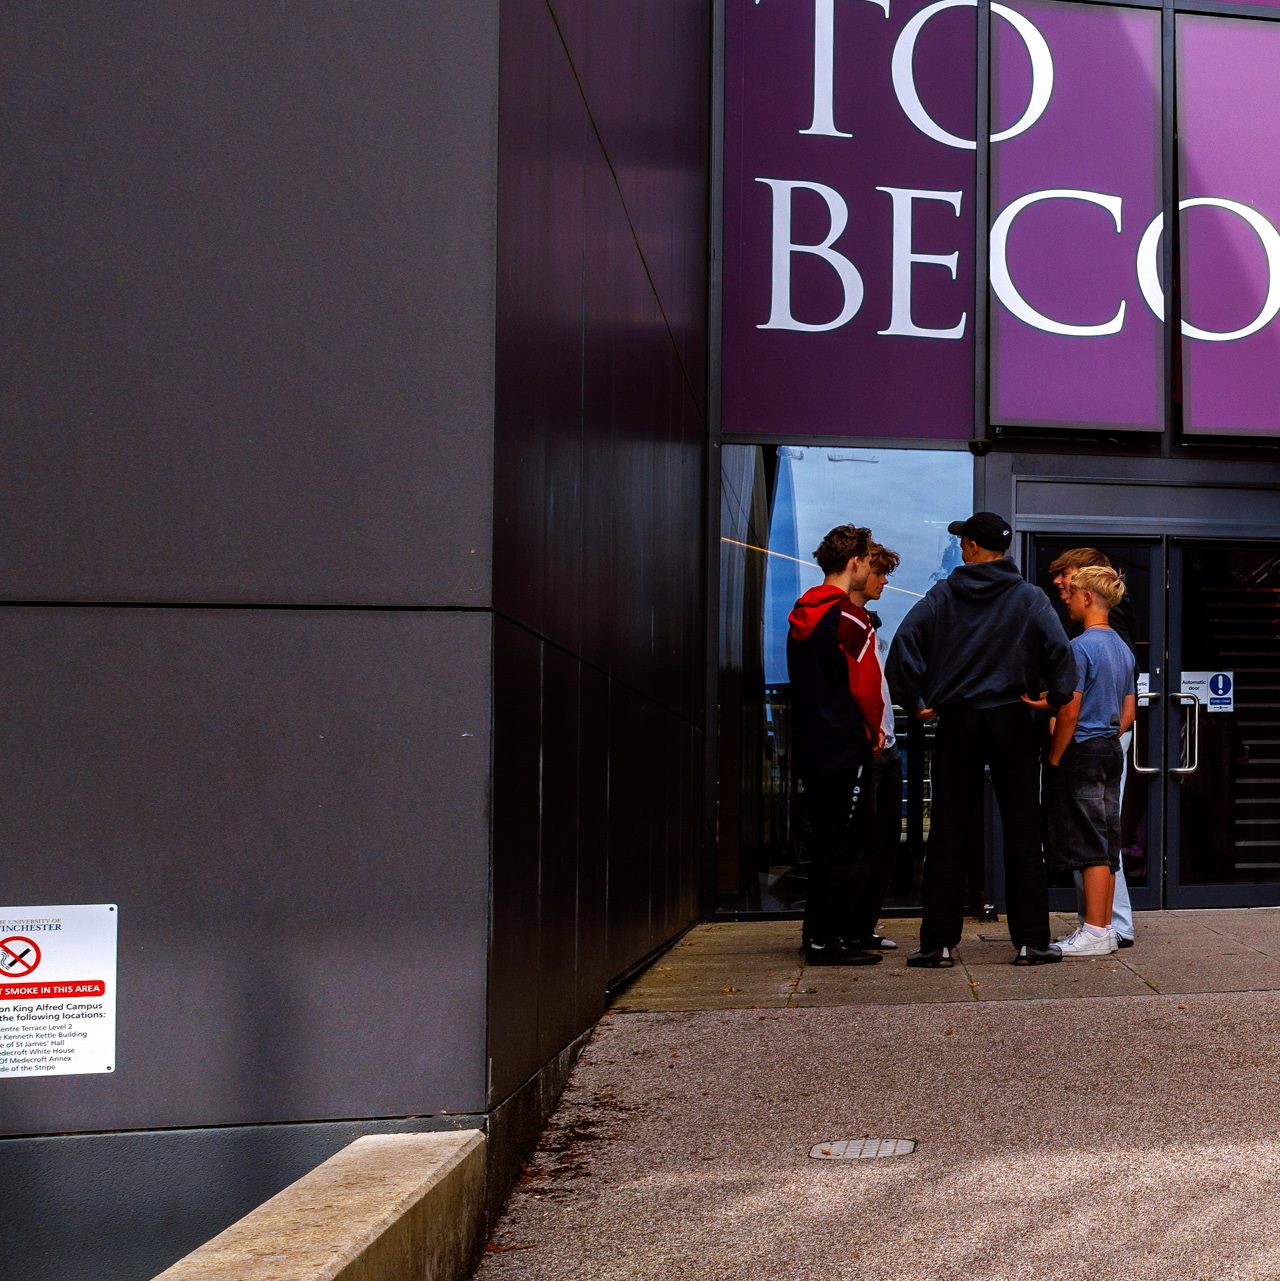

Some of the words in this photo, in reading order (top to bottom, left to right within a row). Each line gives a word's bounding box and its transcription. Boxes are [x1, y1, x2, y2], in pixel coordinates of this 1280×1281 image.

[0, 924, 62, 932] INCHESTER
[5, 987, 39, 995] SMOKE
[40, 986, 51, 994] IN
[53, 985, 73, 993] THIS
[75, 984, 100, 992] AREA
[13, 1004, 34, 1014] King
[36, 1003, 64, 1012] Alfred
[66, 1003, 103, 1011] Campus
[0, 1014, 14, 1022] the
[16, 1013, 60, 1021] following
[9, 1056, 47, 1064] Medecroft
[34, 1064, 56, 1072] Stripe
